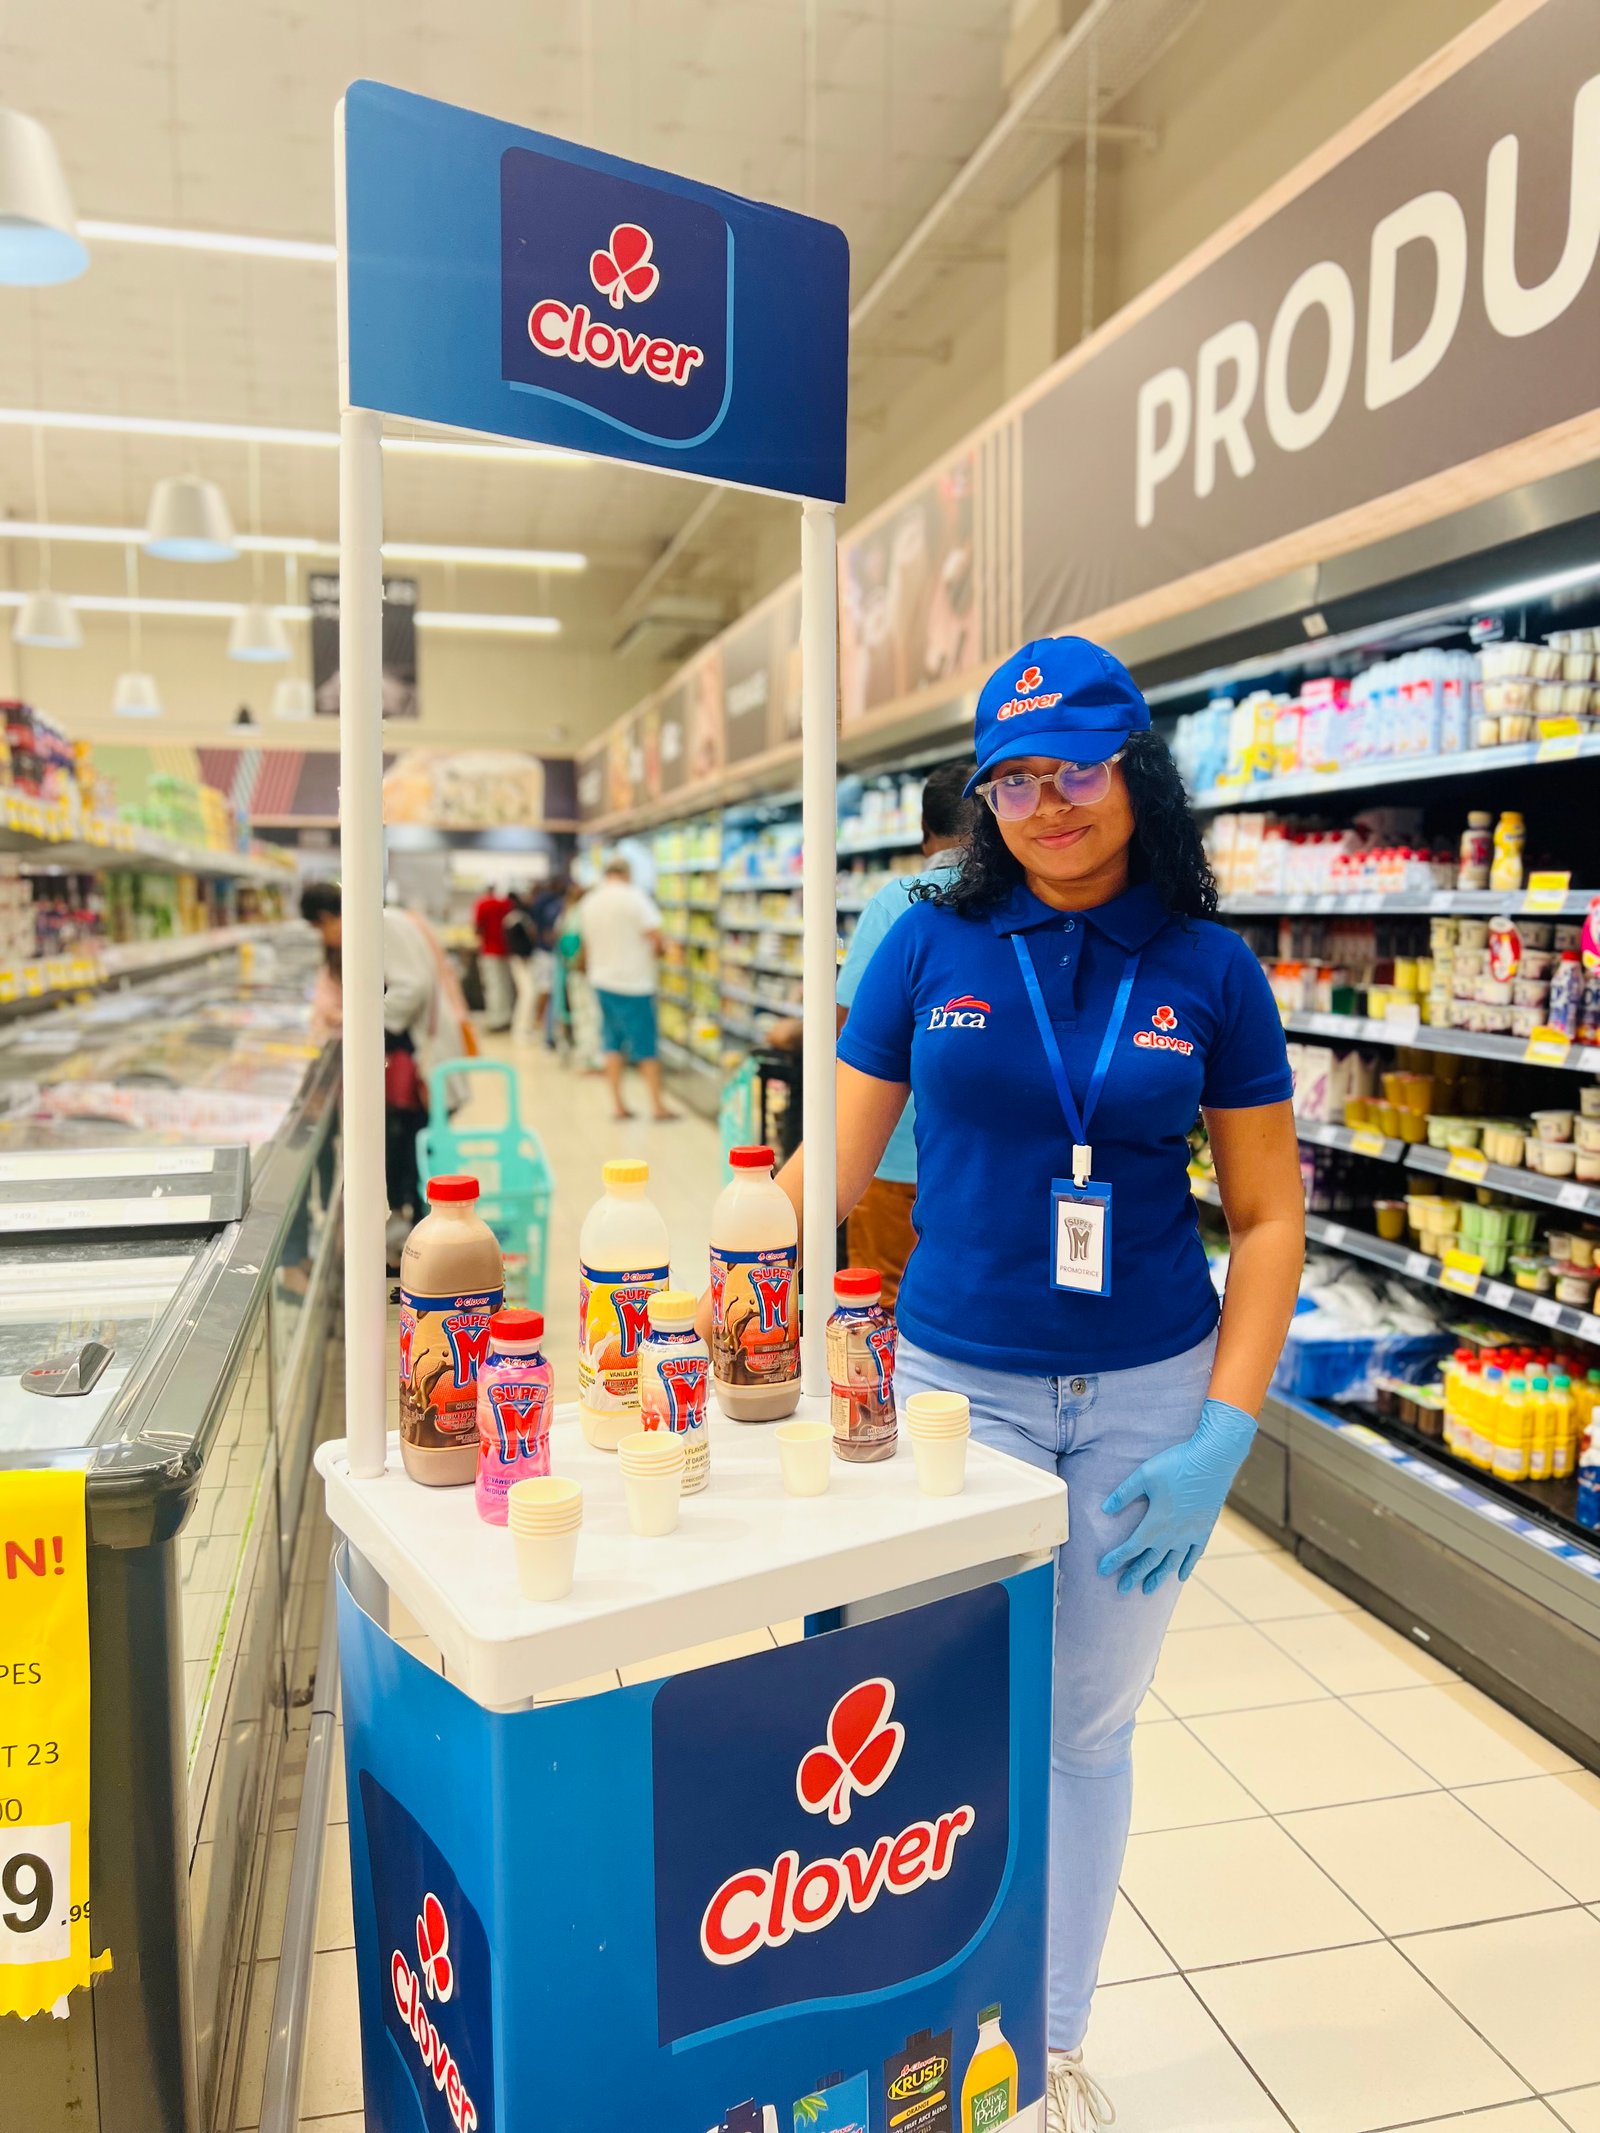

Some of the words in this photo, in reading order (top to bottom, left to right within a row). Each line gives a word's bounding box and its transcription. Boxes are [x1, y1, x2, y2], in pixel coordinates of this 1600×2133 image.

[528, 299, 704, 387] Clover
[997, 692, 1062, 720] Clover
[927, 1004, 987, 1030] Erica
[1133, 1031, 1194, 1056] Clover
[1067, 1217, 1093, 1230] SUPER
[765, 1251, 787, 1260] Clover
[631, 1272, 654, 1281] Clover
[751, 1267, 792, 1281] SUPER
[1060, 1264, 1099, 1278] PROMOTRICE
[463, 1296, 490, 1307] Clover
[757, 1279, 790, 1331] M
[511, 1357, 537, 1367] Clover
[609, 1370, 633, 1378] VANILLA
[491, 1385, 547, 1403] SUPER
[668, 1373, 708, 1434] M
[496, 1401, 544, 1462] M
[5, 1536, 65, 1580] N!
[27, 1741, 59, 1766] 23
[699, 1804, 976, 1966] Clover
[391, 1949, 478, 2133] Clover
[889, 2059, 946, 2099] KRUSH
[905, 2100, 930, 2117] ORANGE
[976, 2098, 1008, 2127] Pride
[980, 2092, 1003, 2110] Olive
[903, 2119, 918, 2132] FRUIT
[917, 2112, 931, 2125] JUICE
[931, 2104, 948, 2117] BLEND
